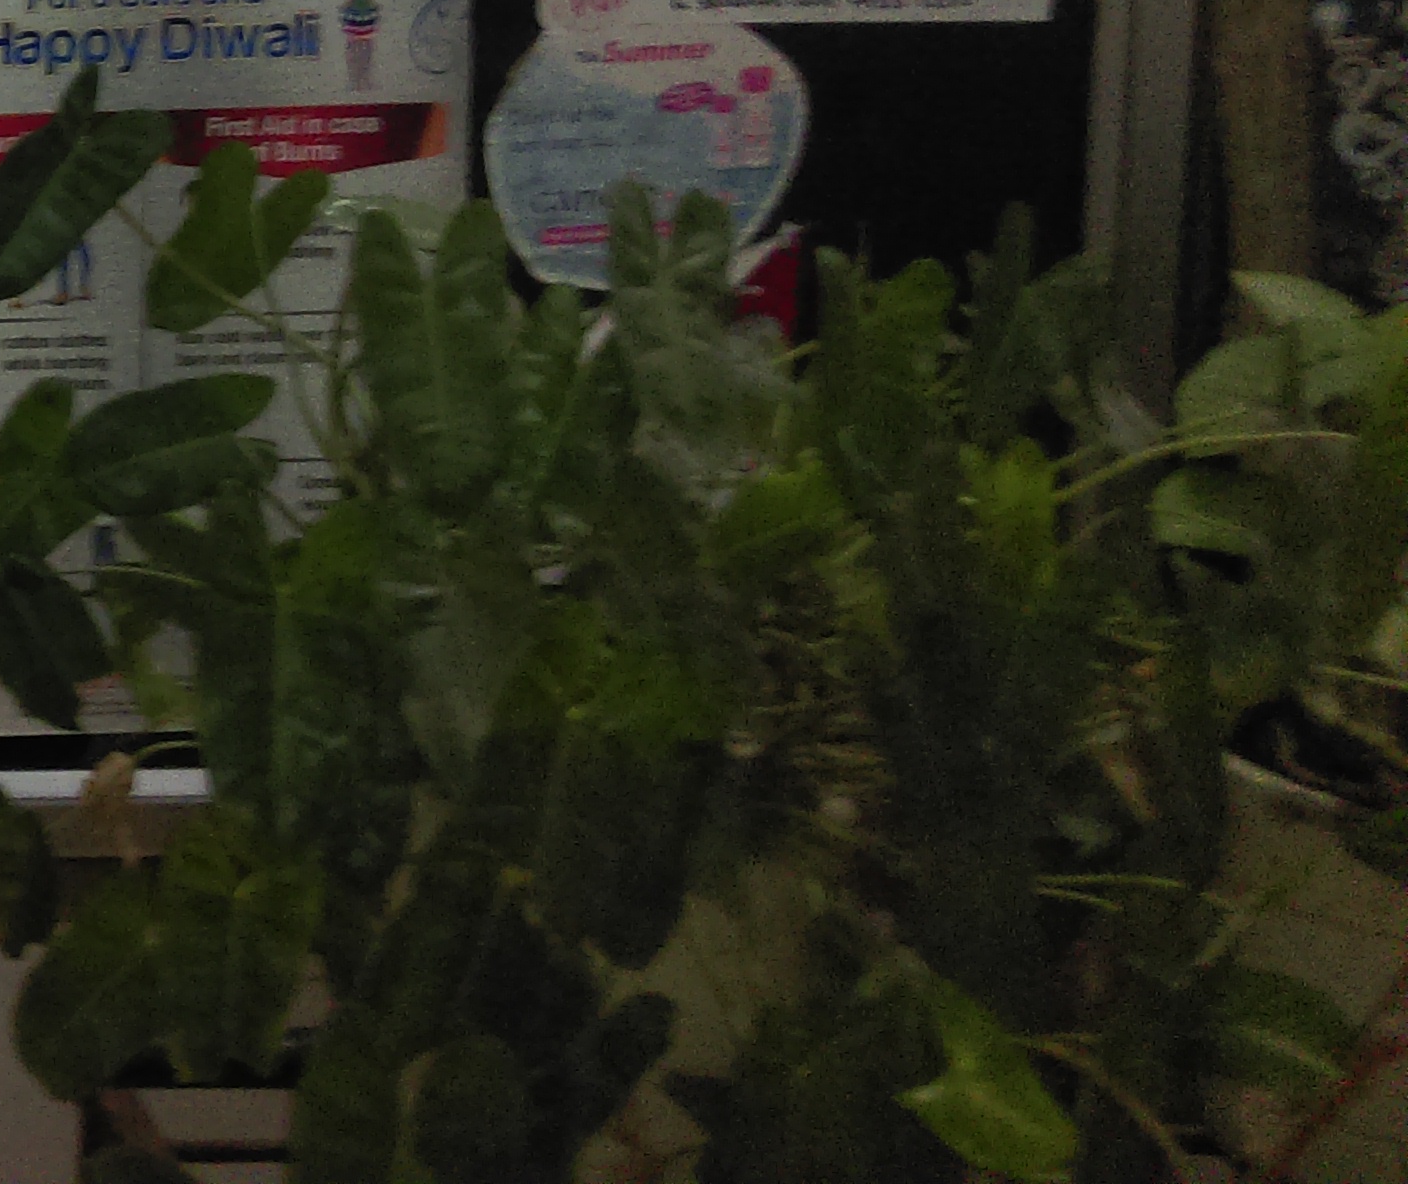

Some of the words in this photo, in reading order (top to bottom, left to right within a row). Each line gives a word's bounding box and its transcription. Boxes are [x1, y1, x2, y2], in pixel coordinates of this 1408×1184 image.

[159, 12, 321, 63] Diwali
[204, 115, 255, 137] First
[260, 114, 297, 136] Aid
[302, 116, 324, 135] in
[329, 116, 382, 134] case
